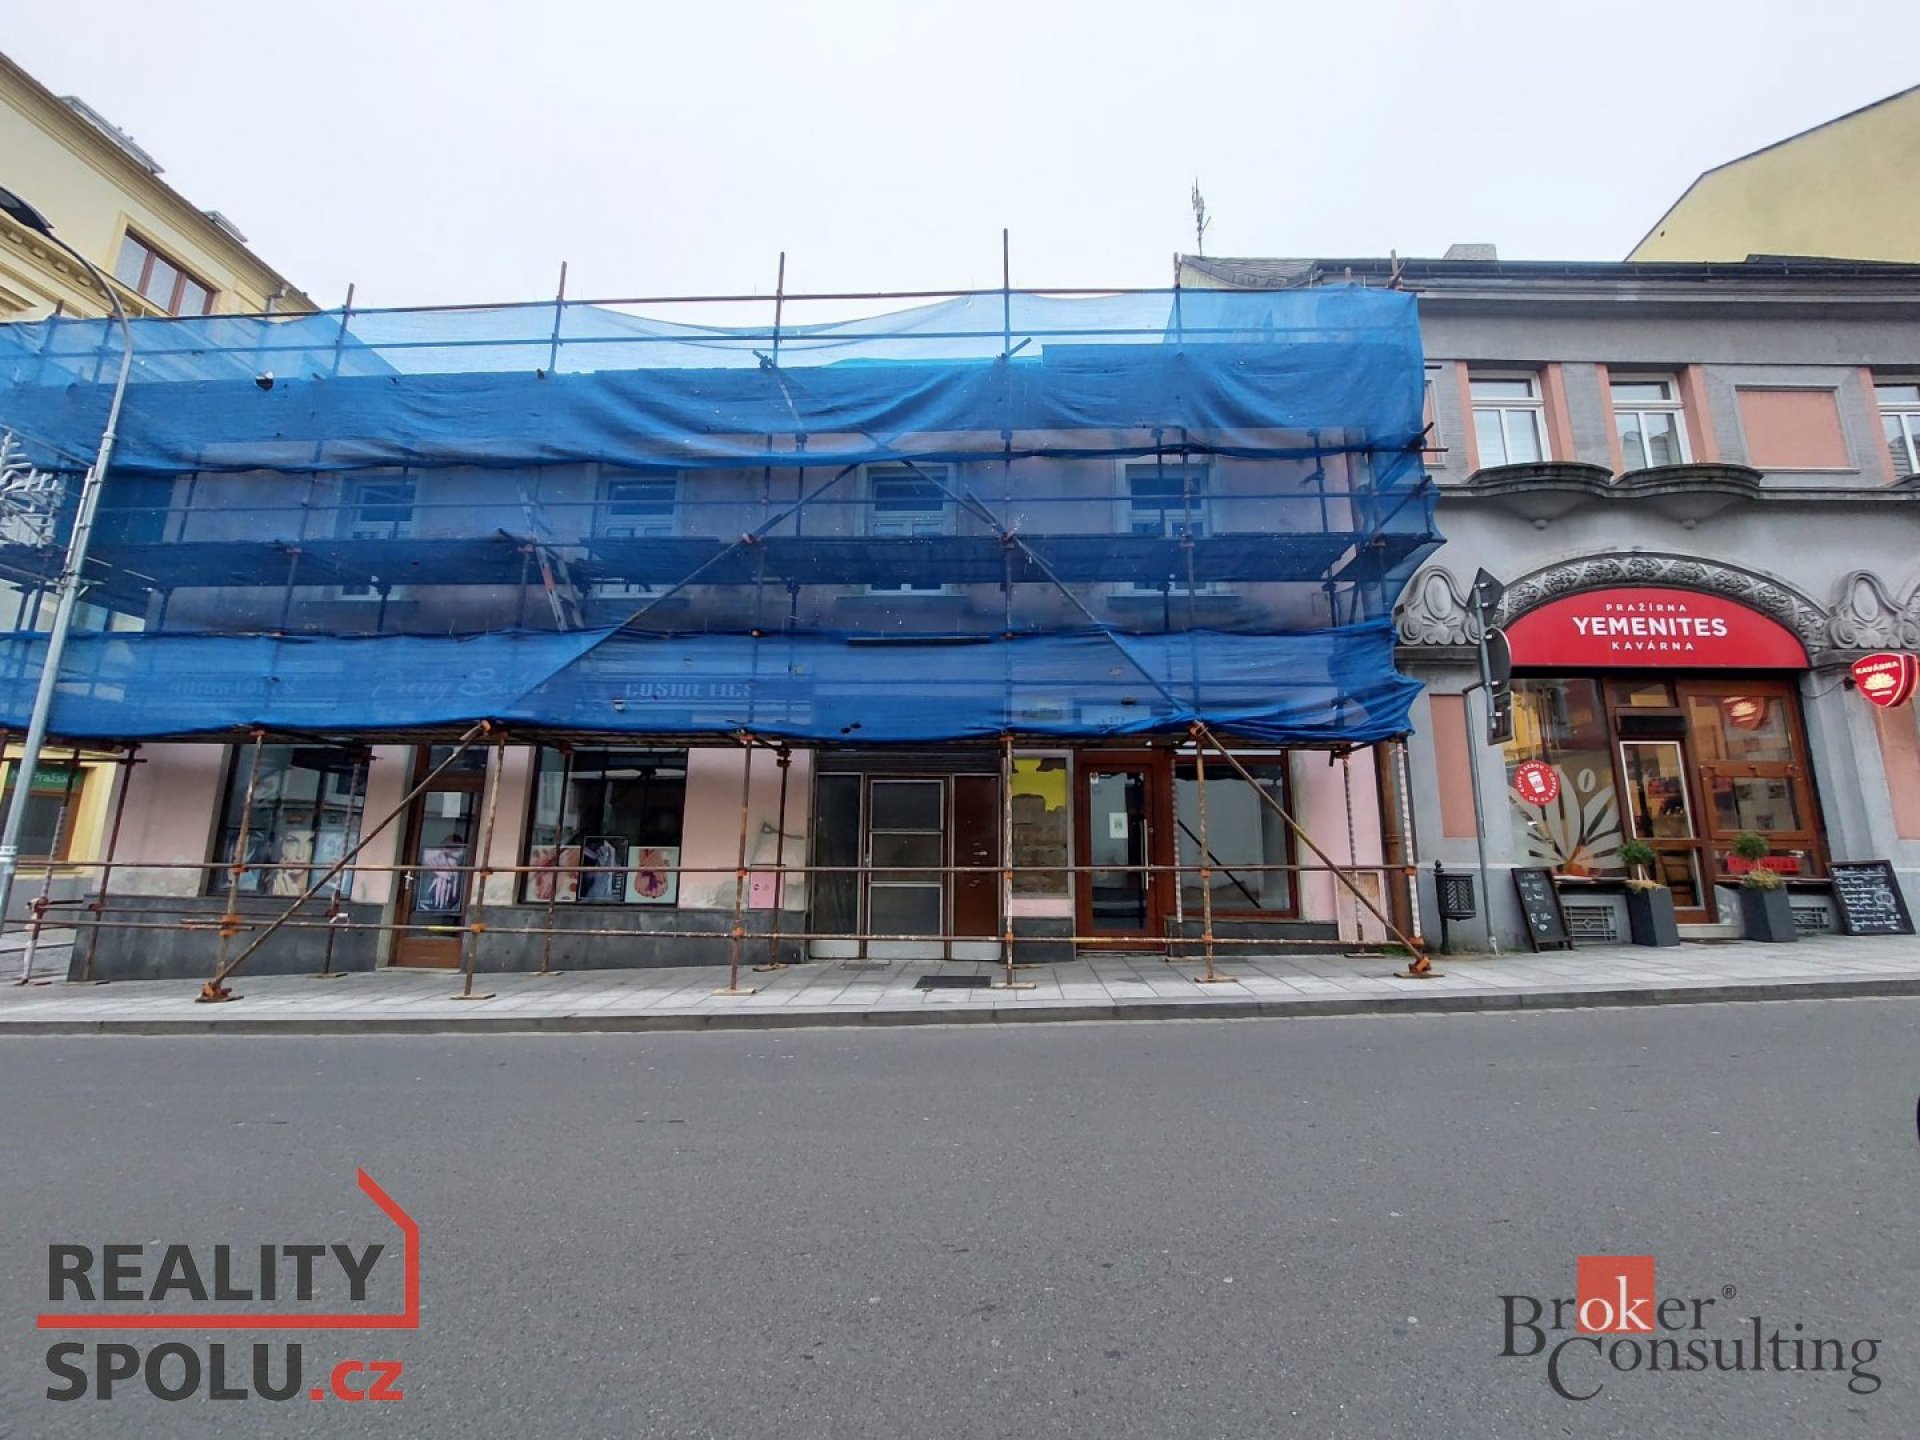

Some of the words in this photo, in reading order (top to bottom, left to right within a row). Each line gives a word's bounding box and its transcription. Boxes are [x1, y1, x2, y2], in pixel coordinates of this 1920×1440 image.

[1605, 602, 1688, 612] PRAŽÍRNA
[1572, 616, 1728, 637] YEMENITES
[1611, 639, 1694, 651] KAVÁRNA
